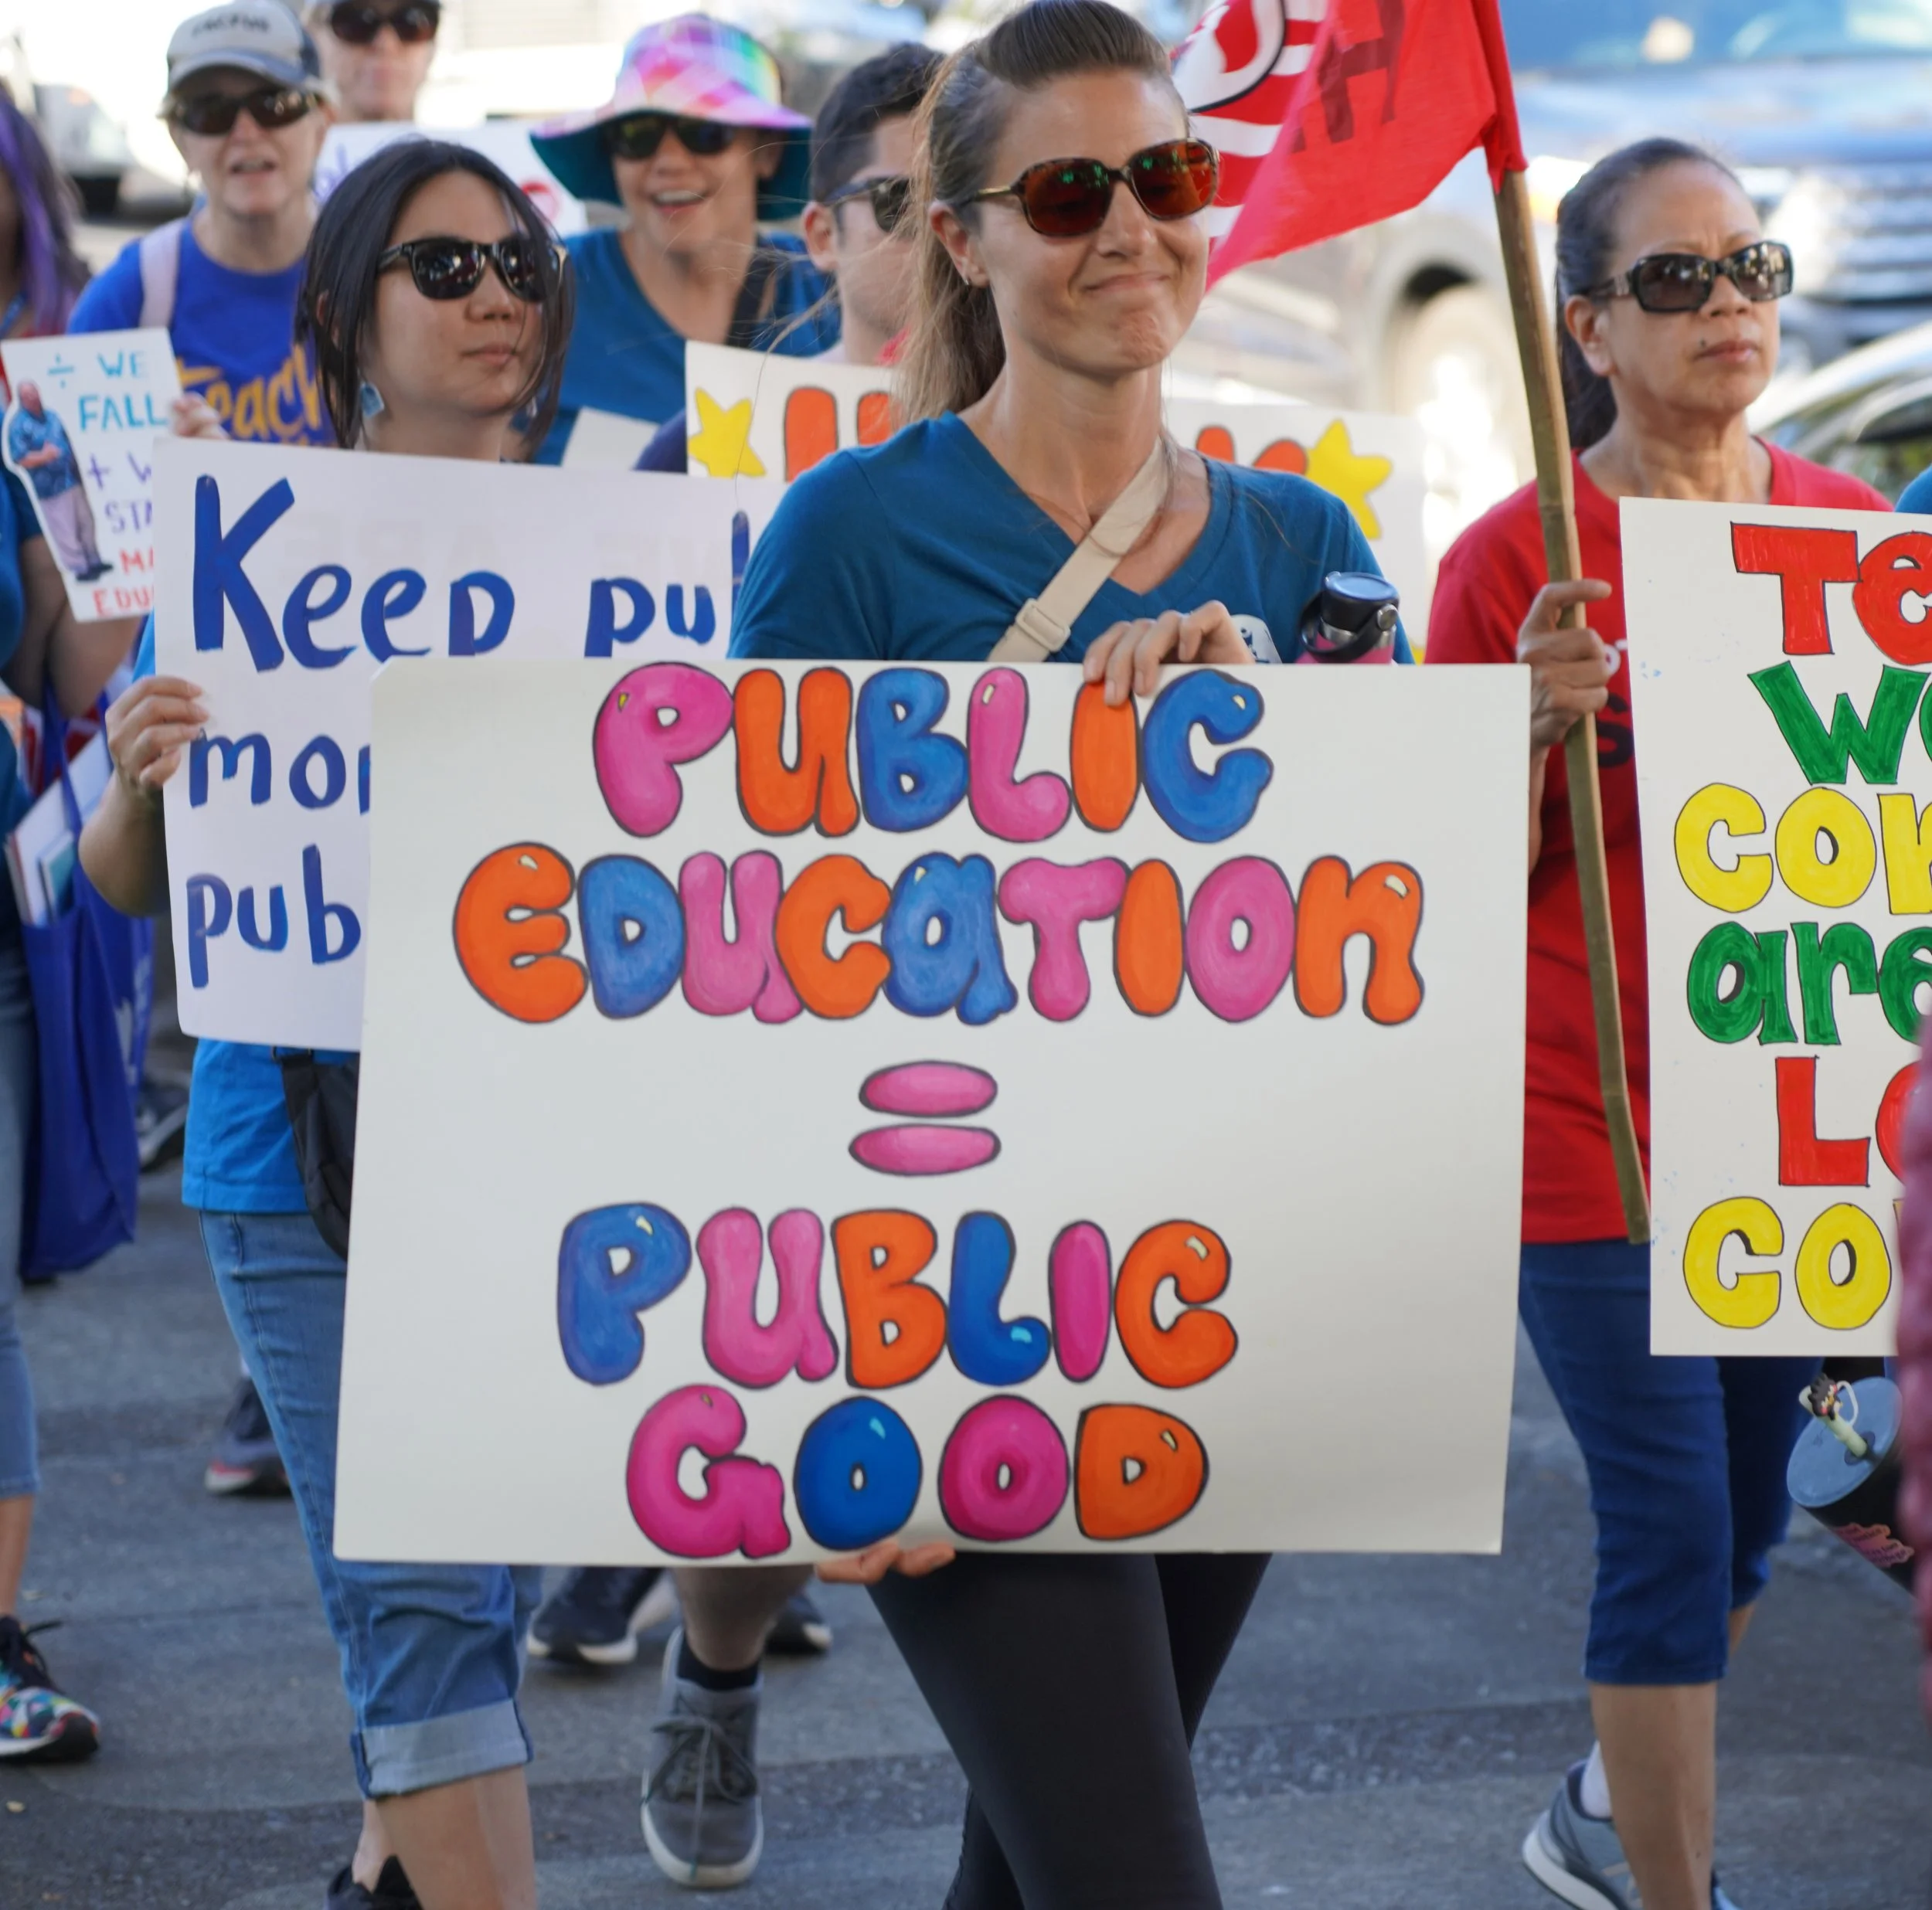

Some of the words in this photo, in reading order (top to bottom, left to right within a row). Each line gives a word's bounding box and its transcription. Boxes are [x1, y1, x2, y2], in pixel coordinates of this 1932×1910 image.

[79, 392, 168, 433] FALL
[97, 350, 147, 379] WE
[592, 661, 1274, 844] PUBLIC
[1747, 661, 1932, 785] W
[556, 1201, 1239, 1390] PUBLIC
[626, 1383, 1209, 1560] GOOD
